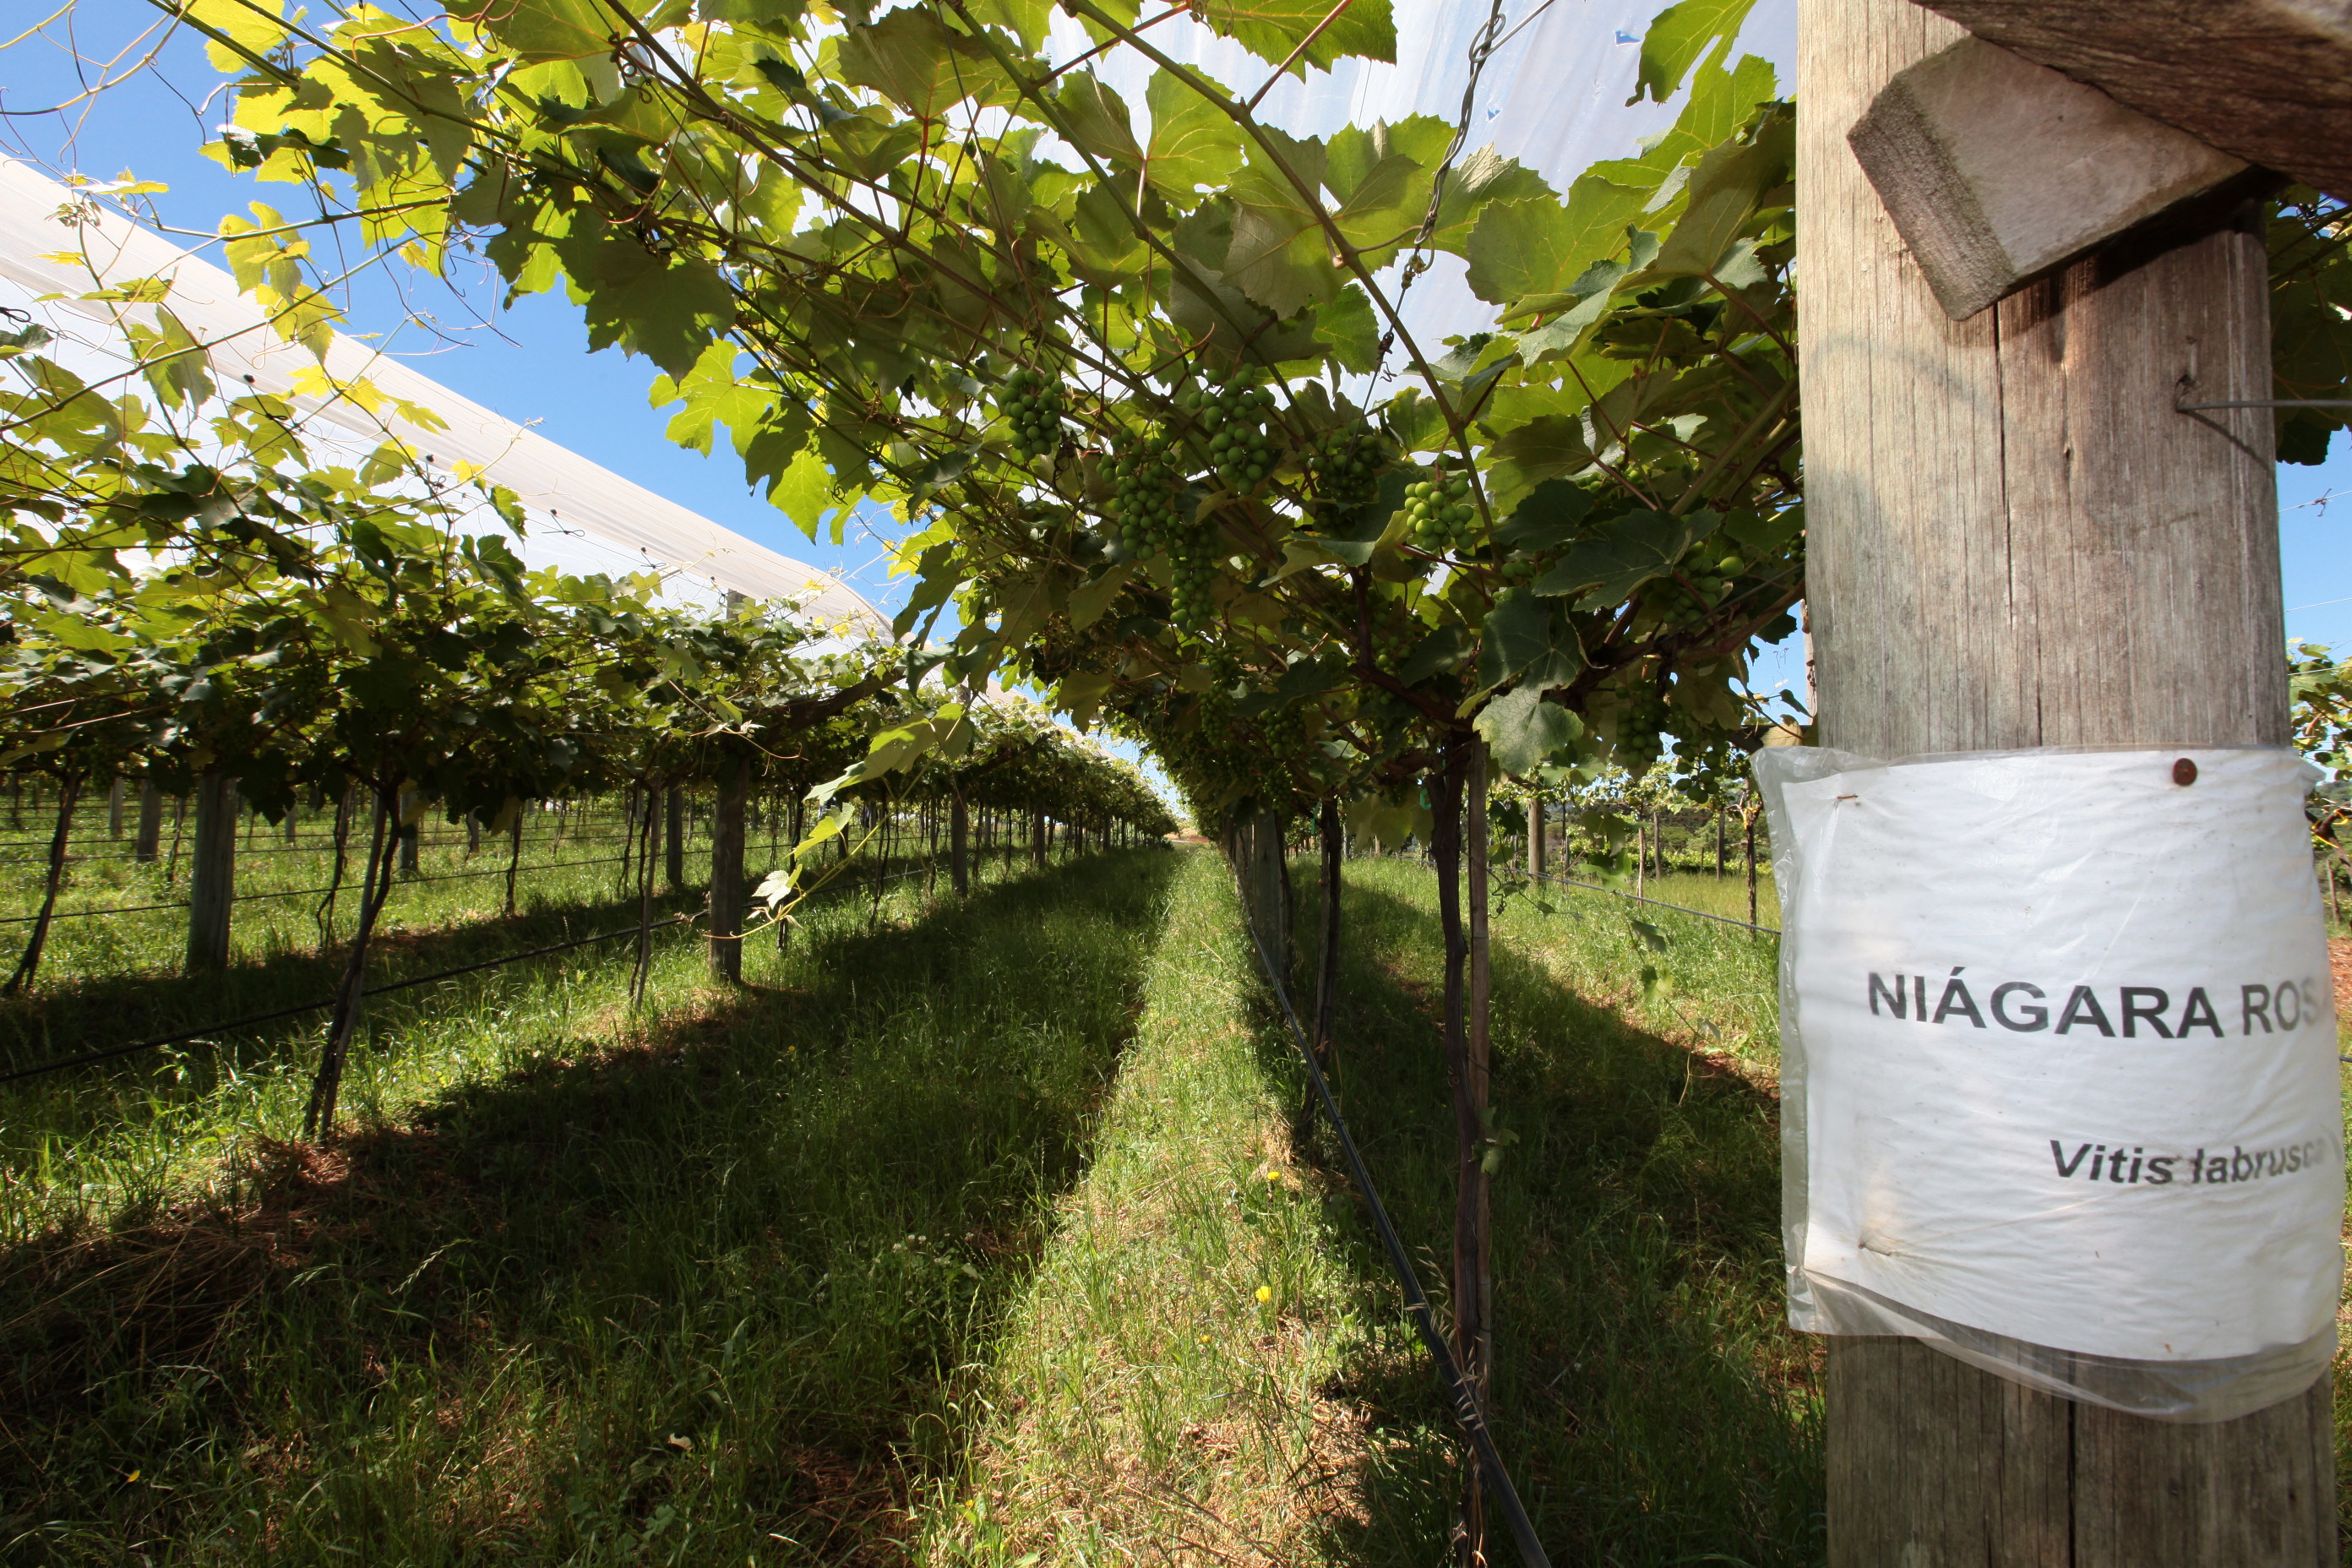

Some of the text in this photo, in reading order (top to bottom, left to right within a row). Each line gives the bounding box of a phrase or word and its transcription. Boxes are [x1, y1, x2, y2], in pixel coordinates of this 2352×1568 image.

[1868, 966, 2328, 1038] NIÁGARA ROS
[2050, 1139, 2174, 1184] Vitis
